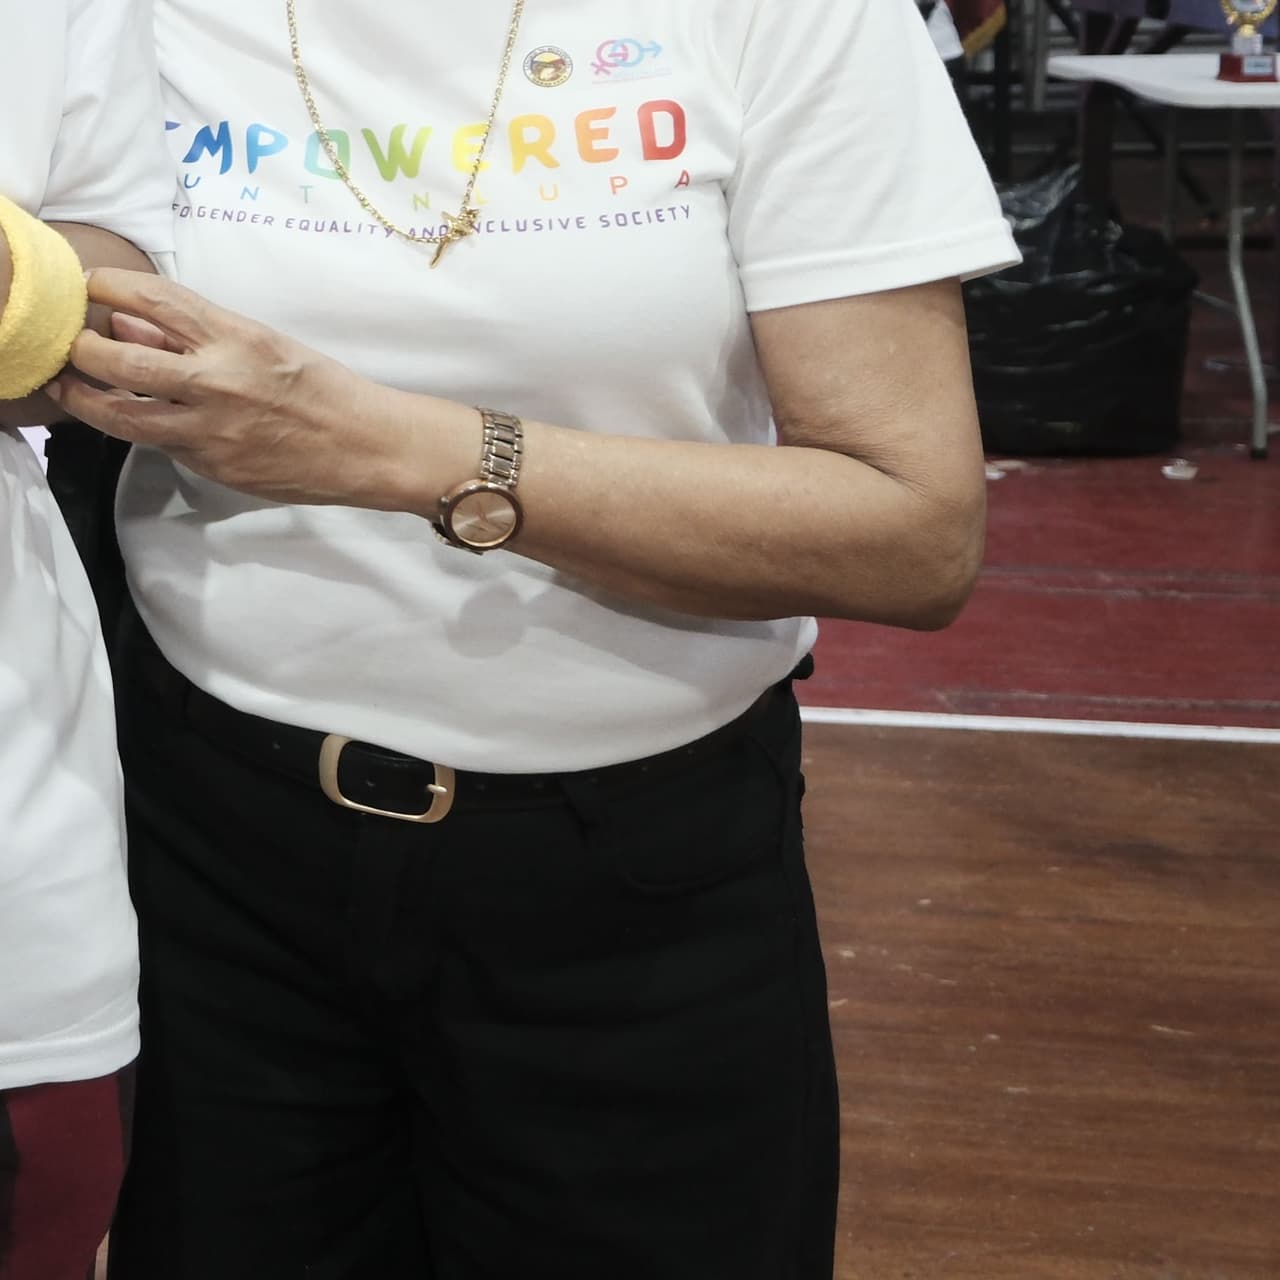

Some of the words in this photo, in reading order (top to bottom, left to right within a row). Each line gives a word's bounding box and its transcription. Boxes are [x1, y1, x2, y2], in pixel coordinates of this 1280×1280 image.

[165, 99, 687, 183] MPOWERED
[197, 205, 275, 226] GENDER
[285, 218, 395, 238] EQUALITY
[408, 224, 449, 240] AND
[470, 216, 587, 234] NCLUSIVE
[600, 204, 691, 228] SOCIETY
